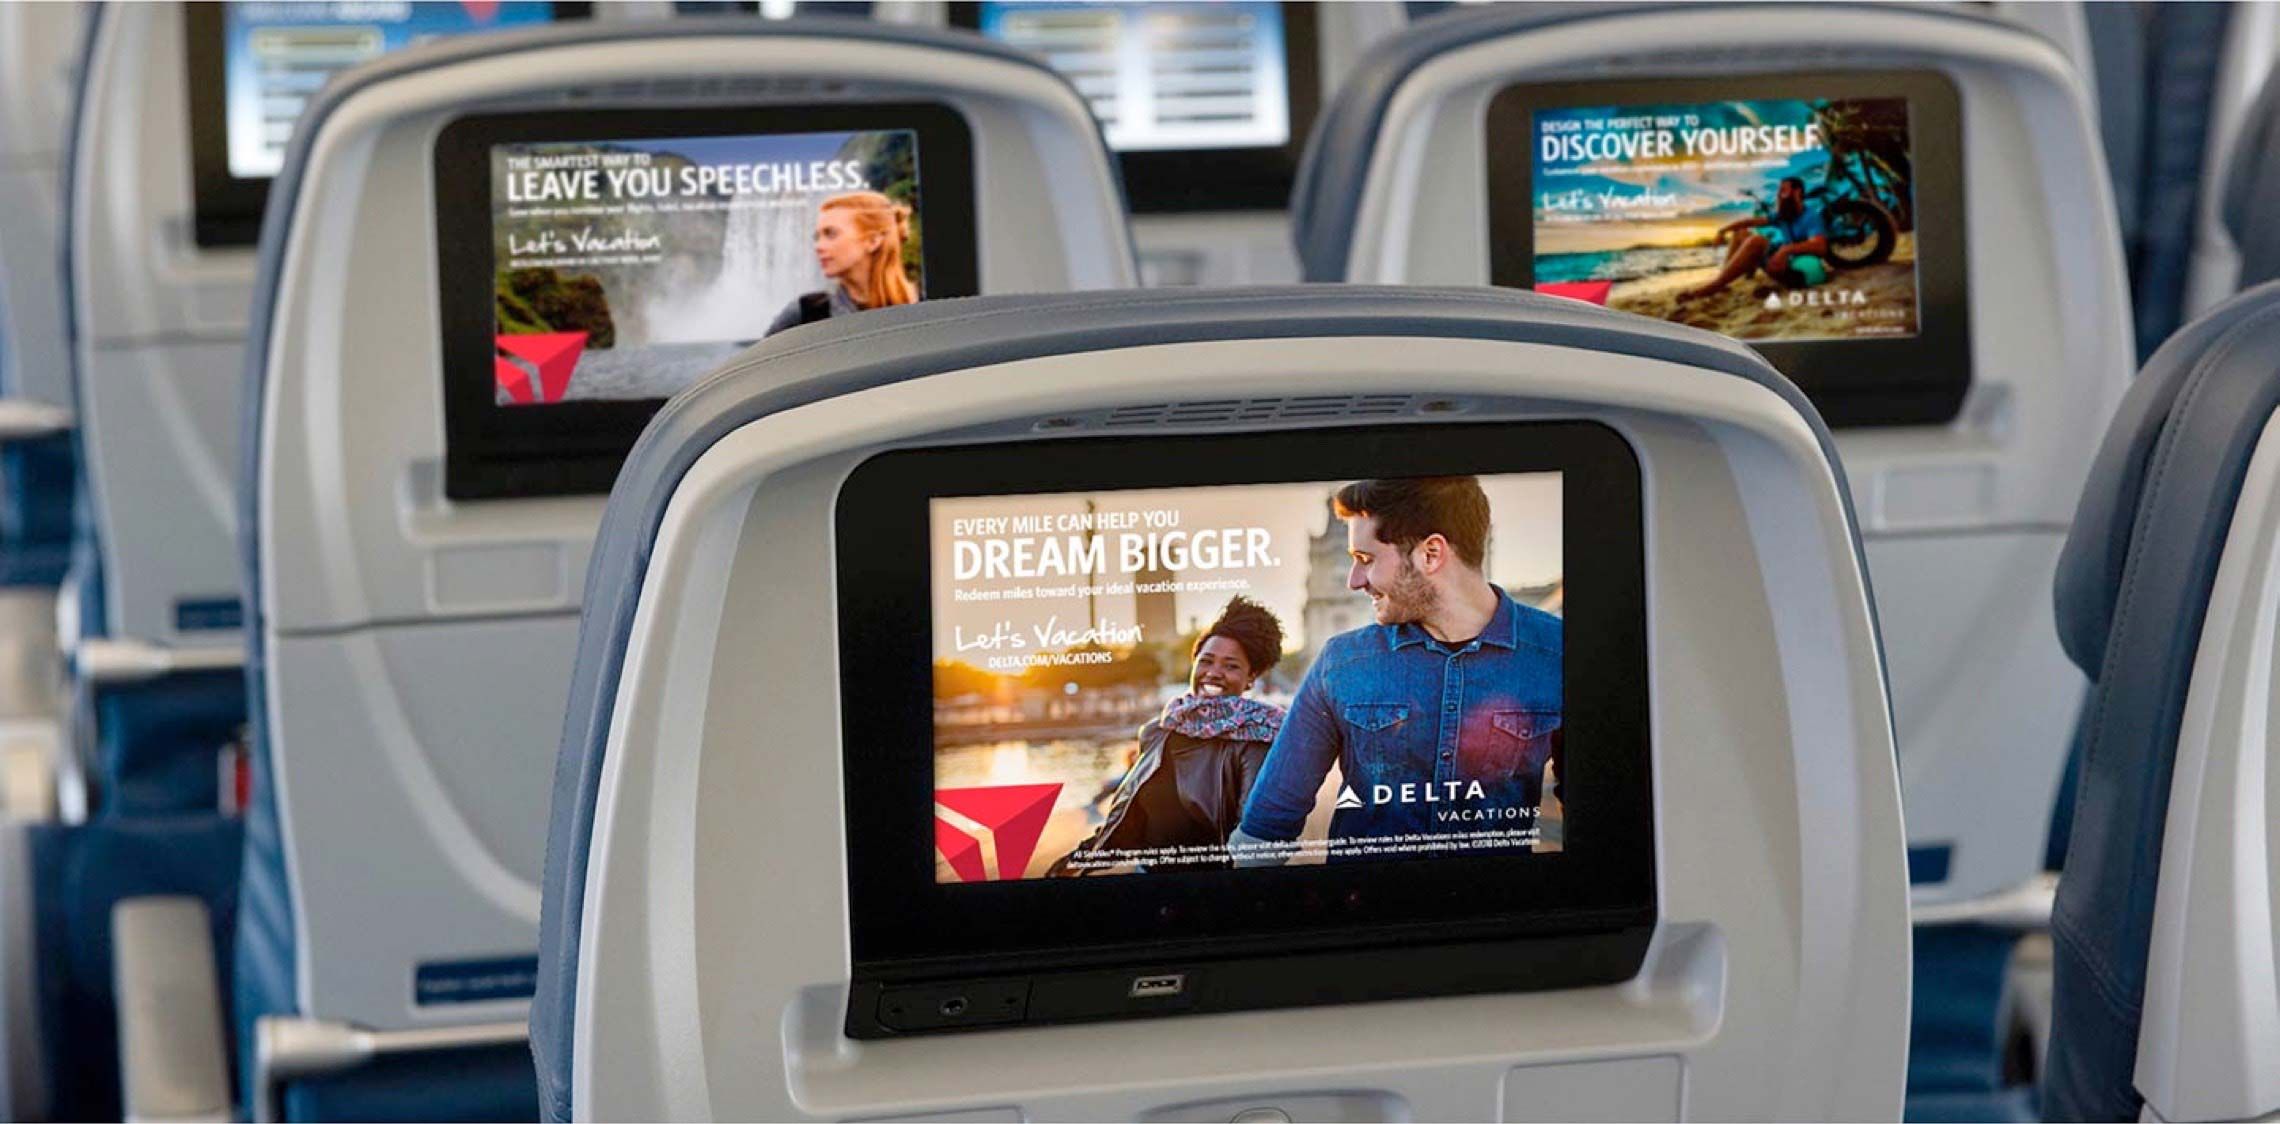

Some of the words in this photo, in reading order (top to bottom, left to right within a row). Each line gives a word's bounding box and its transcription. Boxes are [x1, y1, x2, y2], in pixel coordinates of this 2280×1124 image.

[1584, 118, 1604, 131] THE
[1607, 116, 1653, 130] PERFECT
[1684, 114, 1700, 127] TO
[1541, 130, 1675, 162] DISCOVER
[1681, 124, 1823, 156] YOURSELF.
[507, 156, 532, 170] THE
[535, 154, 599, 169] SMARTEST
[602, 153, 632, 168] WAY
[634, 152, 652, 167] TO
[507, 170, 599, 202] LEAVE
[605, 167, 672, 199] YOU
[680, 160, 871, 196] SPEECHLESS.
[508, 230, 567, 256] Let's
[571, 225, 662, 252] Vacation
[1789, 289, 1867, 306] DELTA
[953, 517, 1008, 537] EVERY
[1012, 515, 1053, 534] MILE
[1057, 513, 1093, 532] CAN
[1097, 511, 1139, 530] HELP
[1142, 509, 1180, 528] YOU
[953, 535, 1106, 580] DREAM
[1120, 528, 1281, 573] BIGGER.
[955, 588, 1001, 602] Redeem
[1003, 586, 1034, 600] miles
[1035, 584, 1075, 598] toward
[1077, 585, 1103, 599] your
[1106, 581, 1134, 596] ideal
[1136, 579, 1184, 594] vacation
[1186, 577, 1251, 595] experience.
[954, 620, 1026, 651] Let's
[1033, 616, 1144, 648] Vacation
[988, 651, 1112, 669] DELTA.COM/VACATIONS
[1373, 779, 1486, 805] DELTA
[1437, 806, 1542, 822] VACATIONS
[1208, 843, 1219, 851] the
[1404, 833, 1421, 842] Delta
[1493, 838, 1510, 847] Delta
